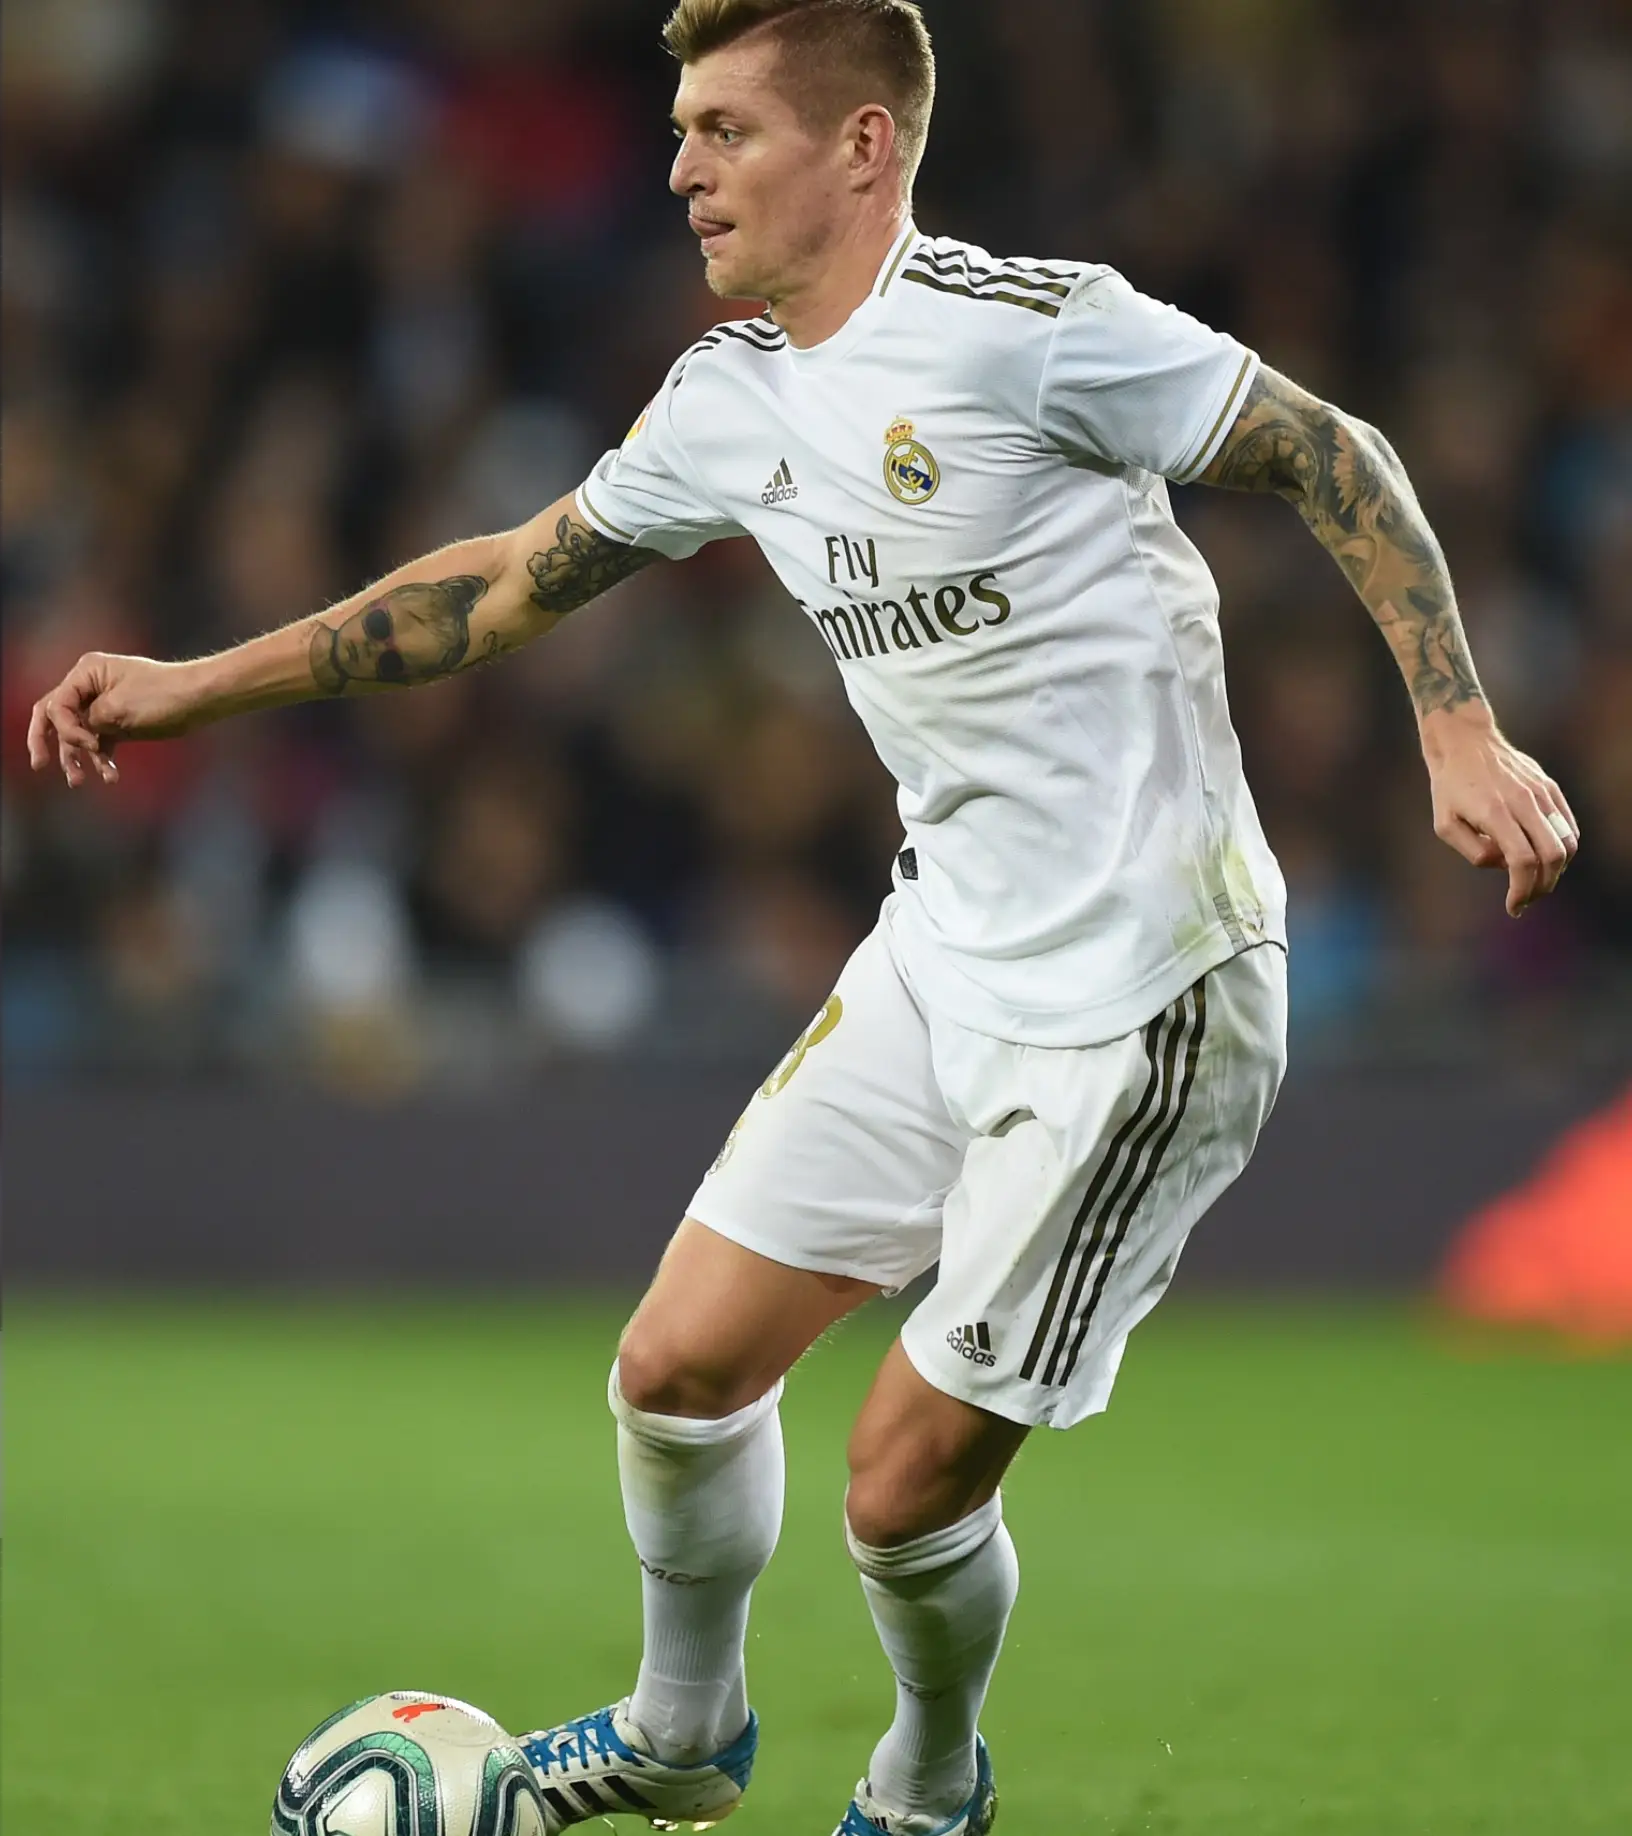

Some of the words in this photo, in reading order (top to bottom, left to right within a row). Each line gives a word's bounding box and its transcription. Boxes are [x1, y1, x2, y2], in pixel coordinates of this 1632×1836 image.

[761, 485, 798, 504] adidas
[825, 534, 879, 588] Fly
[796, 572, 1011, 661] mirates
[946, 1331, 997, 1367] adidas
